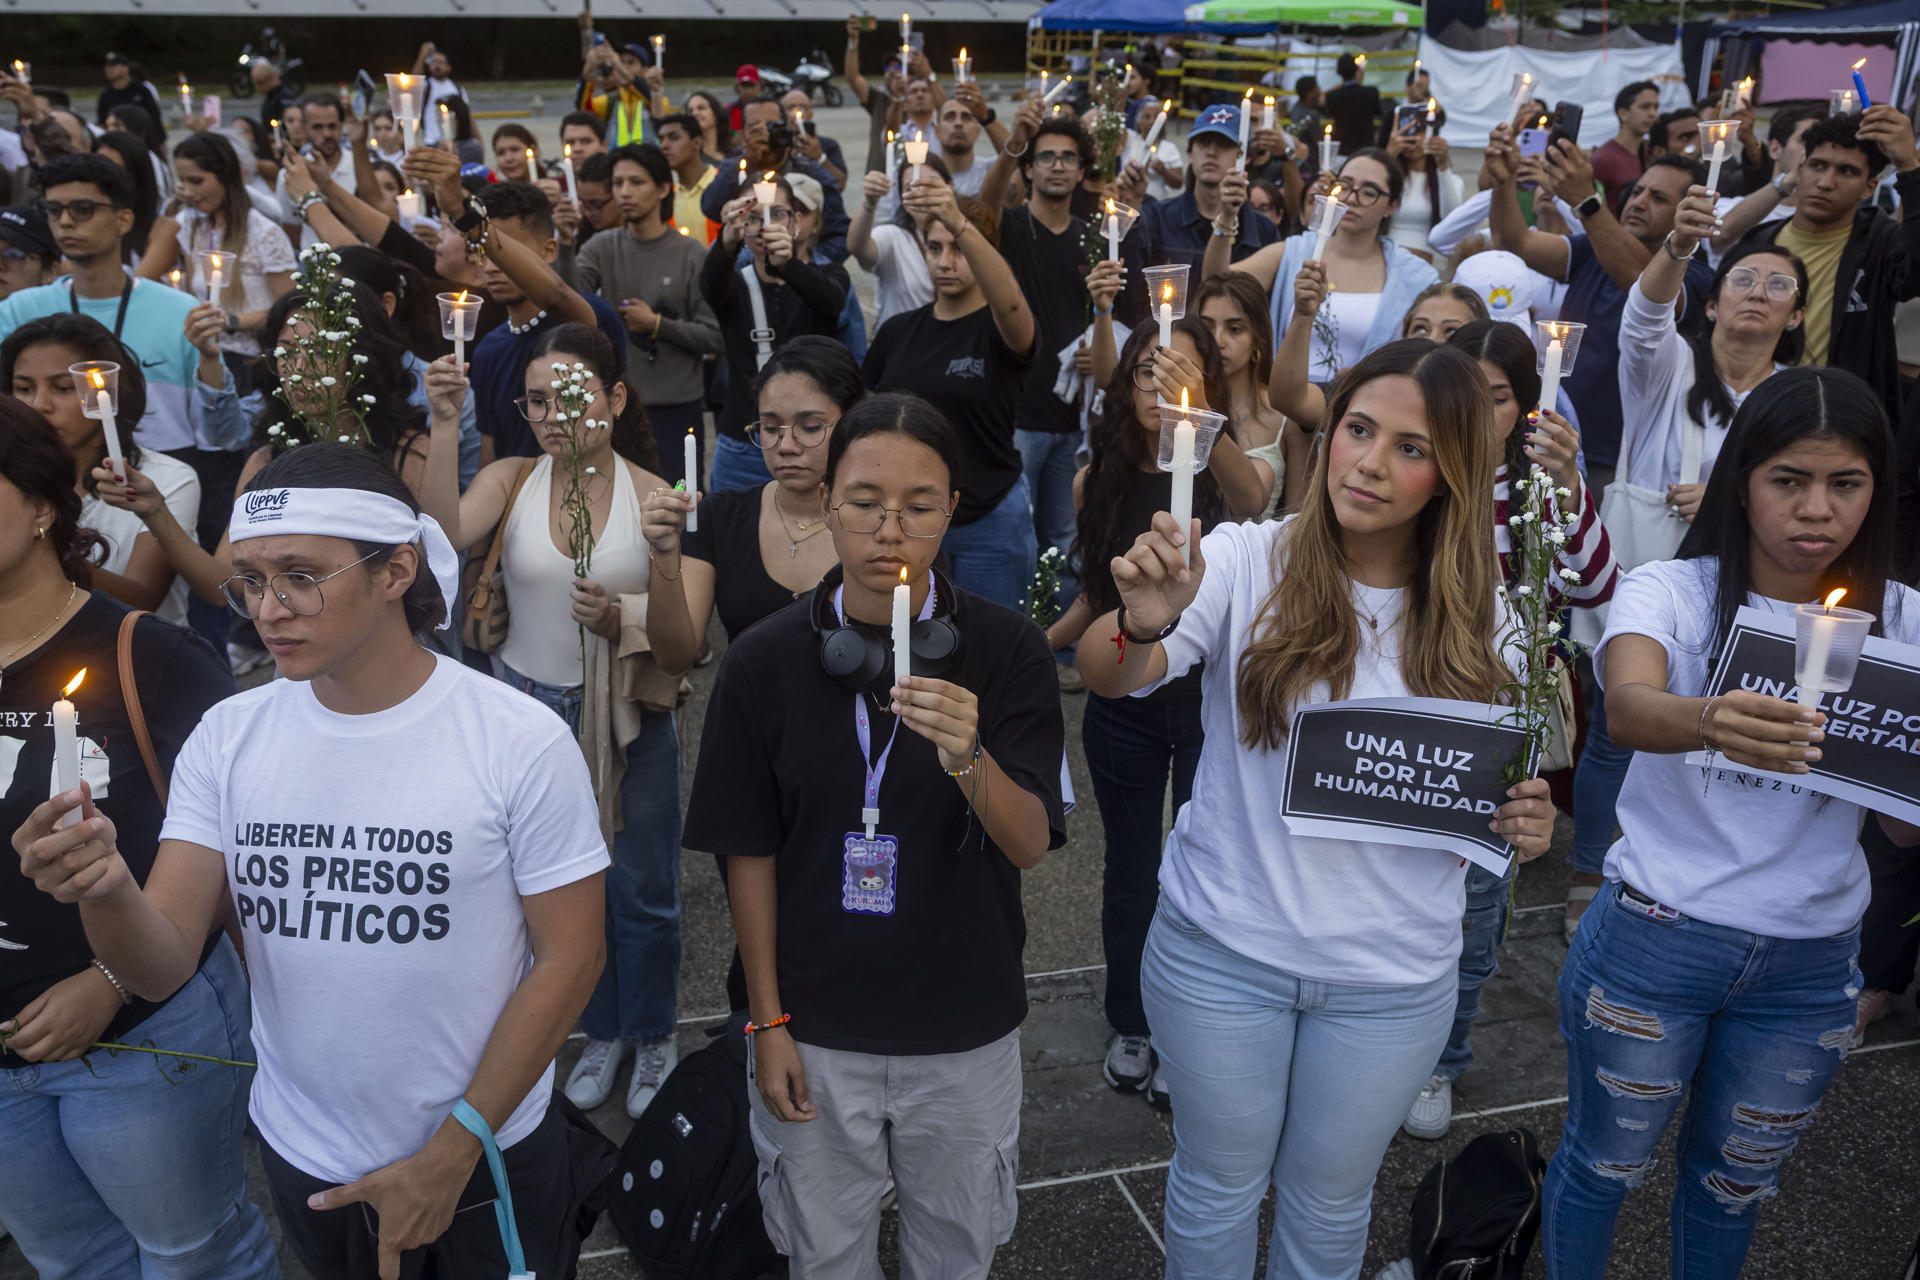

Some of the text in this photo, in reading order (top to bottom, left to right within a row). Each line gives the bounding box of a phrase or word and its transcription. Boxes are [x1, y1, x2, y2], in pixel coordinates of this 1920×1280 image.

[1740, 673, 1799, 701] UNA
[1816, 692, 1876, 722] LUZ
[44, 711, 80, 727] 11
[1345, 730, 1474, 772] UNA LUZ
[1314, 772, 1496, 815] HUMANIDAD
[1355, 757, 1460, 792] POR LA
[235, 822, 453, 855] LIBEREN A TODOS
[234, 852, 450, 895] LOS PRESOS
[237, 890, 450, 944] POLÍTICOS
